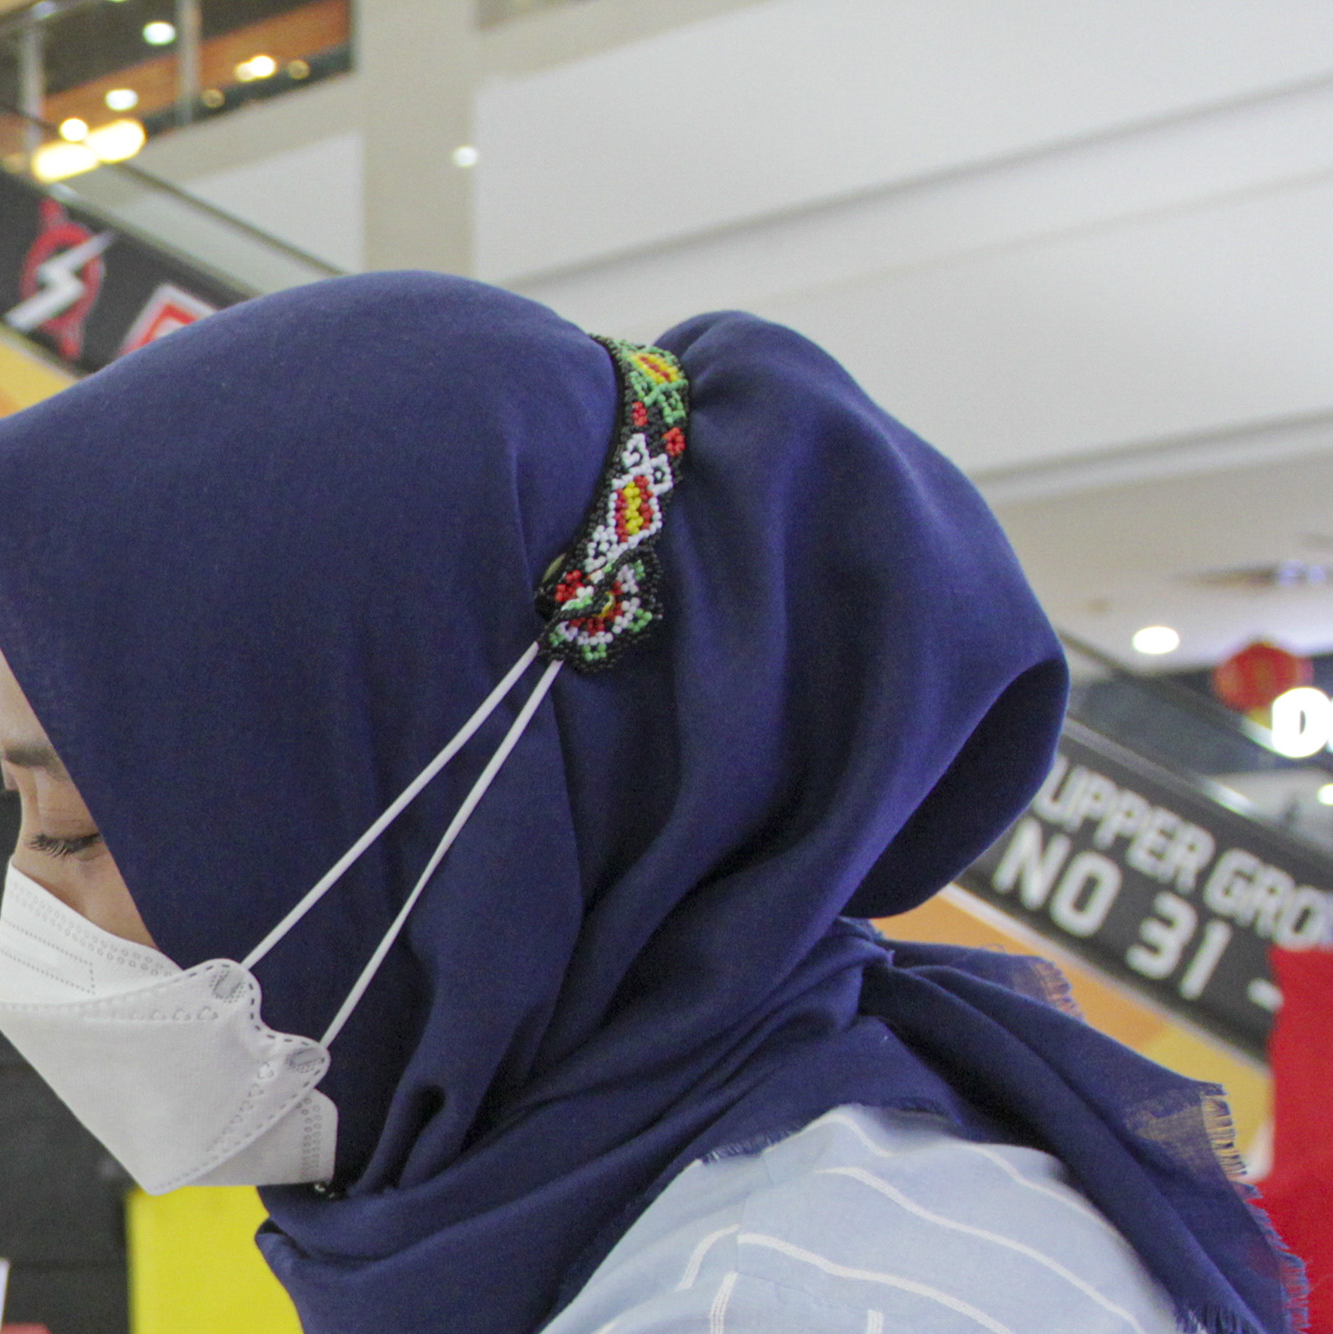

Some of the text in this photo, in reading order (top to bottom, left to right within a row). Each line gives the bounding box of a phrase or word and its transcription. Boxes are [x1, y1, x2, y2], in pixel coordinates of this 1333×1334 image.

[992, 819, 1122, 938] NO
[1126, 891, 1230, 1000] 31
[1034, 754, 1333, 952] UPPER GRO
